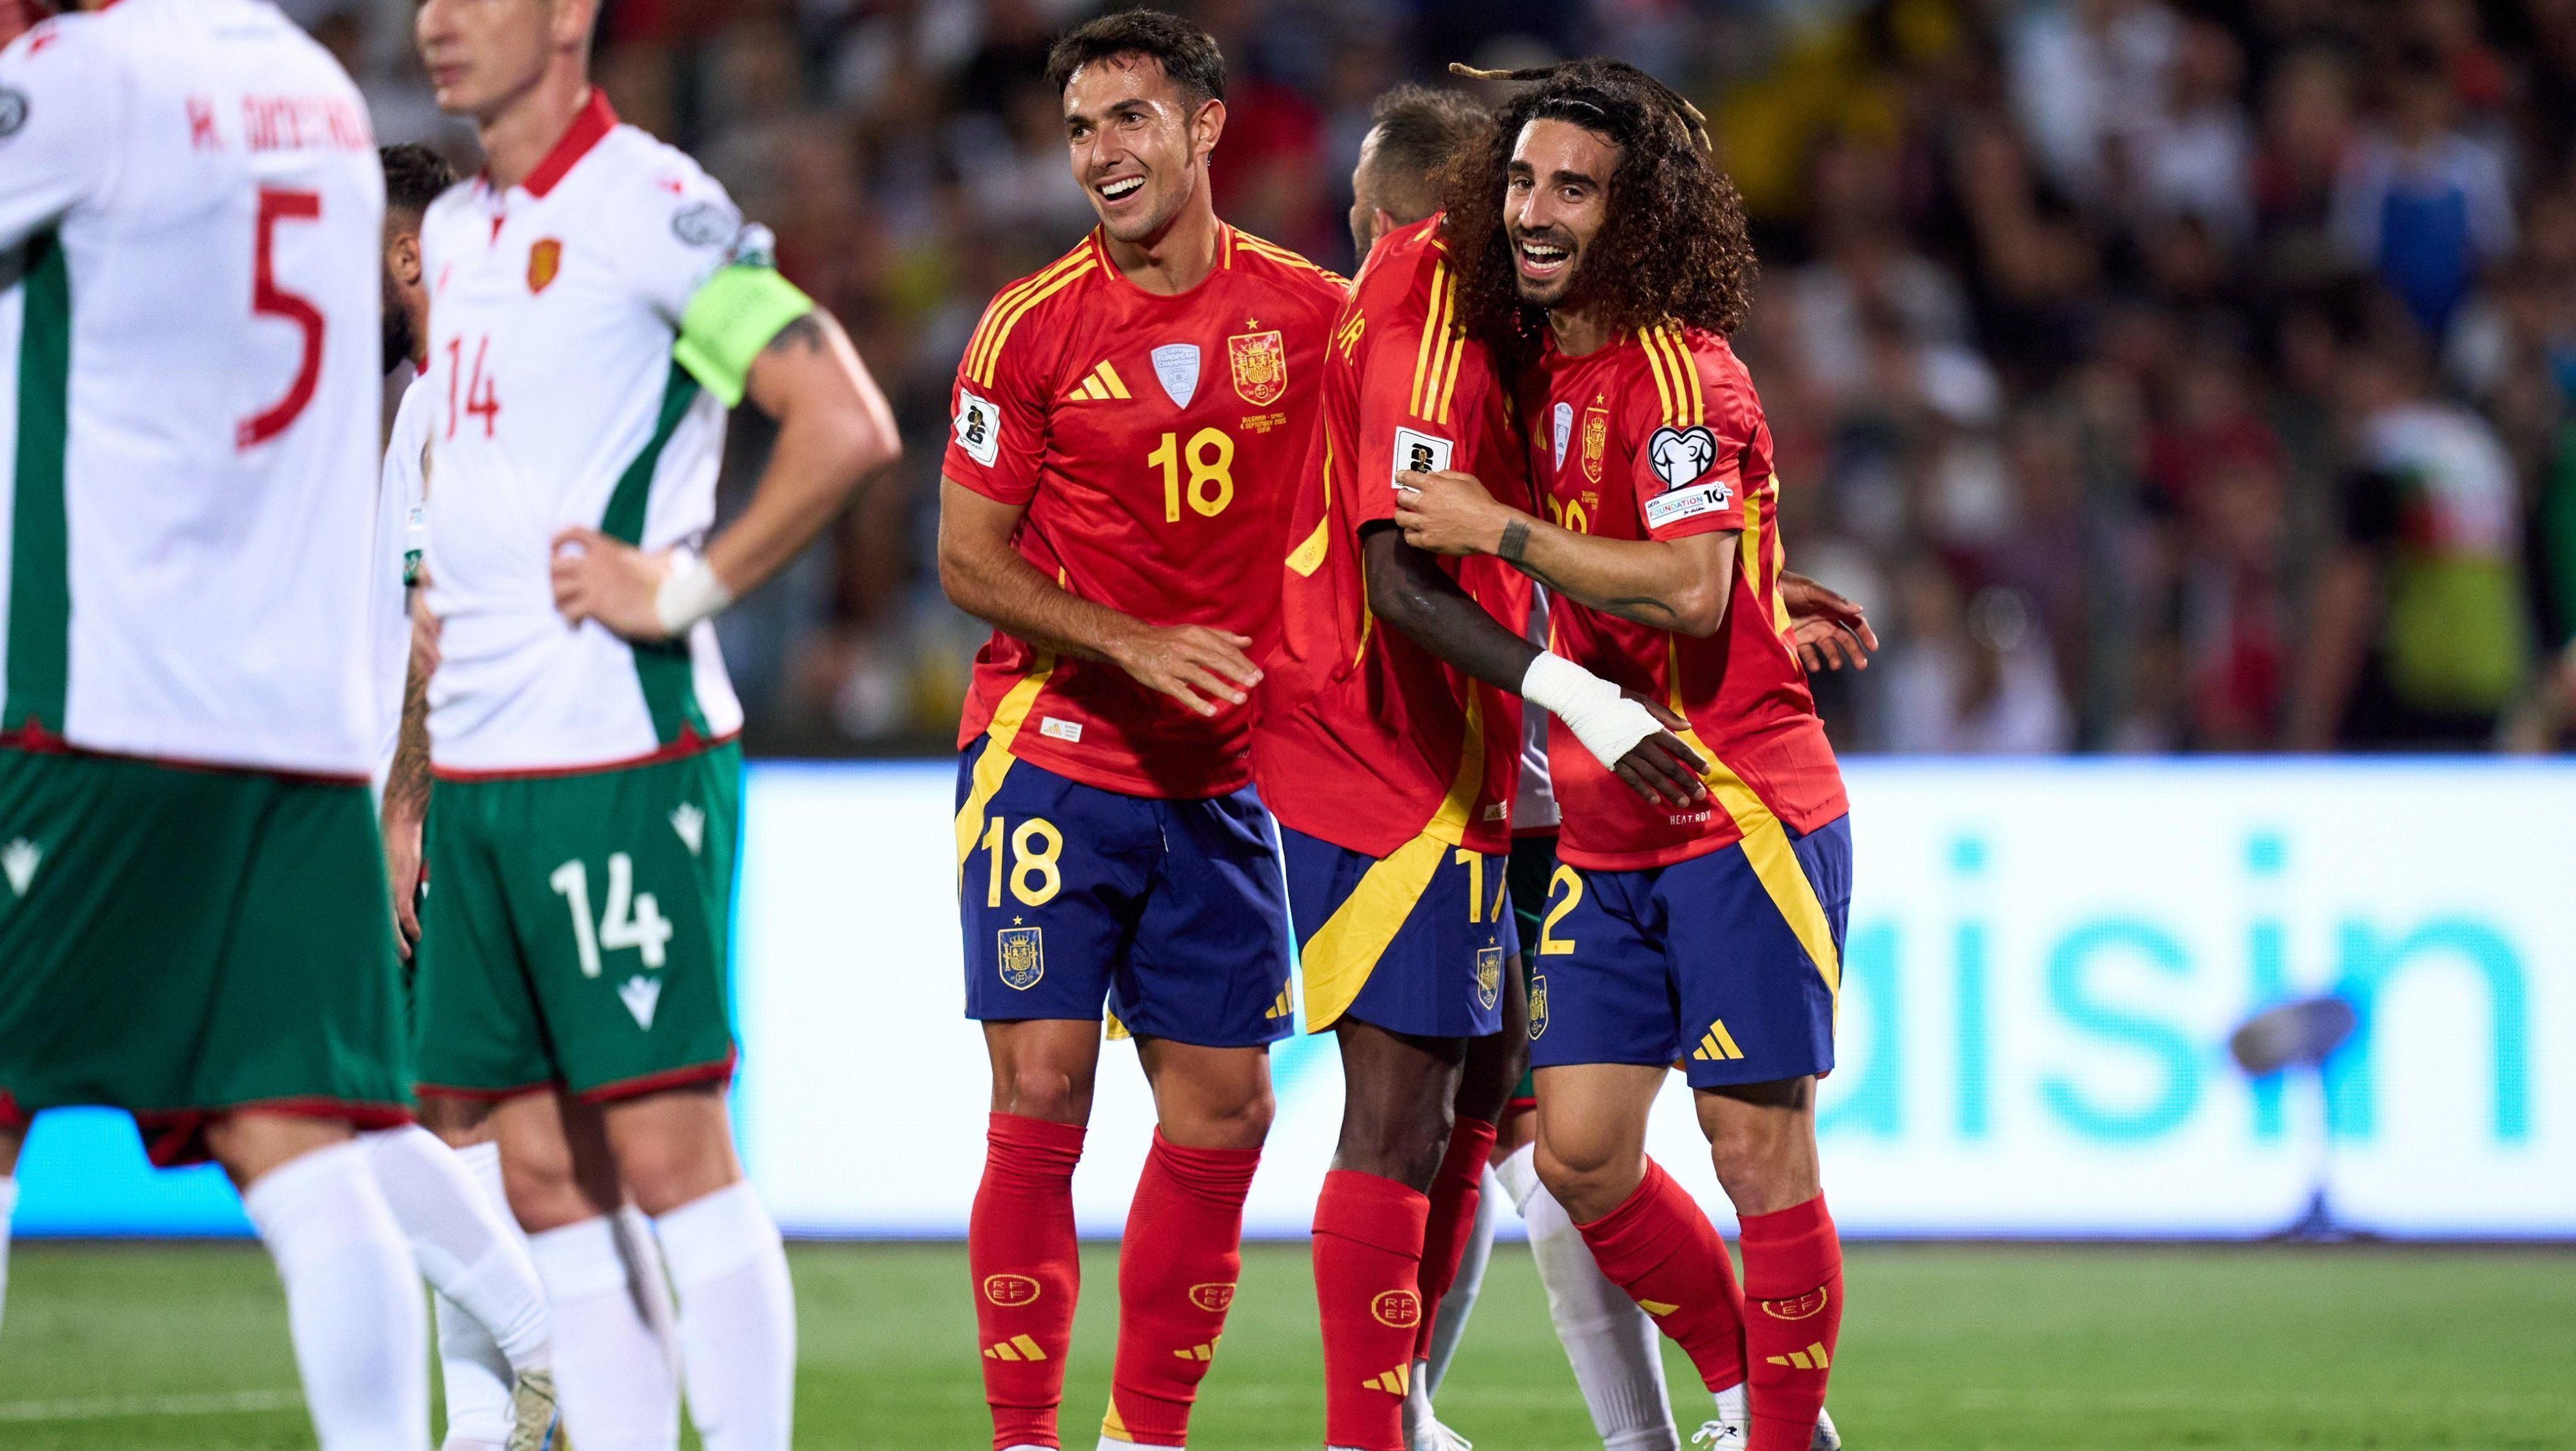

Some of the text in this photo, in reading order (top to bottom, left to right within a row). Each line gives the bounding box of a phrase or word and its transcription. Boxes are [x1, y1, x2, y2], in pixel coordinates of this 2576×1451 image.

[235, 186, 325, 452] 5
[446, 335, 500, 438] 14
[1148, 427, 1235, 523] 18
[1649, 496, 1703, 518] FOUNDATION
[1703, 489, 1724, 504] 10
[981, 816, 1063, 908] 18
[1670, 810, 1711, 825] HEAT.RDY
[550, 852, 674, 979] 14
[1540, 864, 1583, 955] 2
